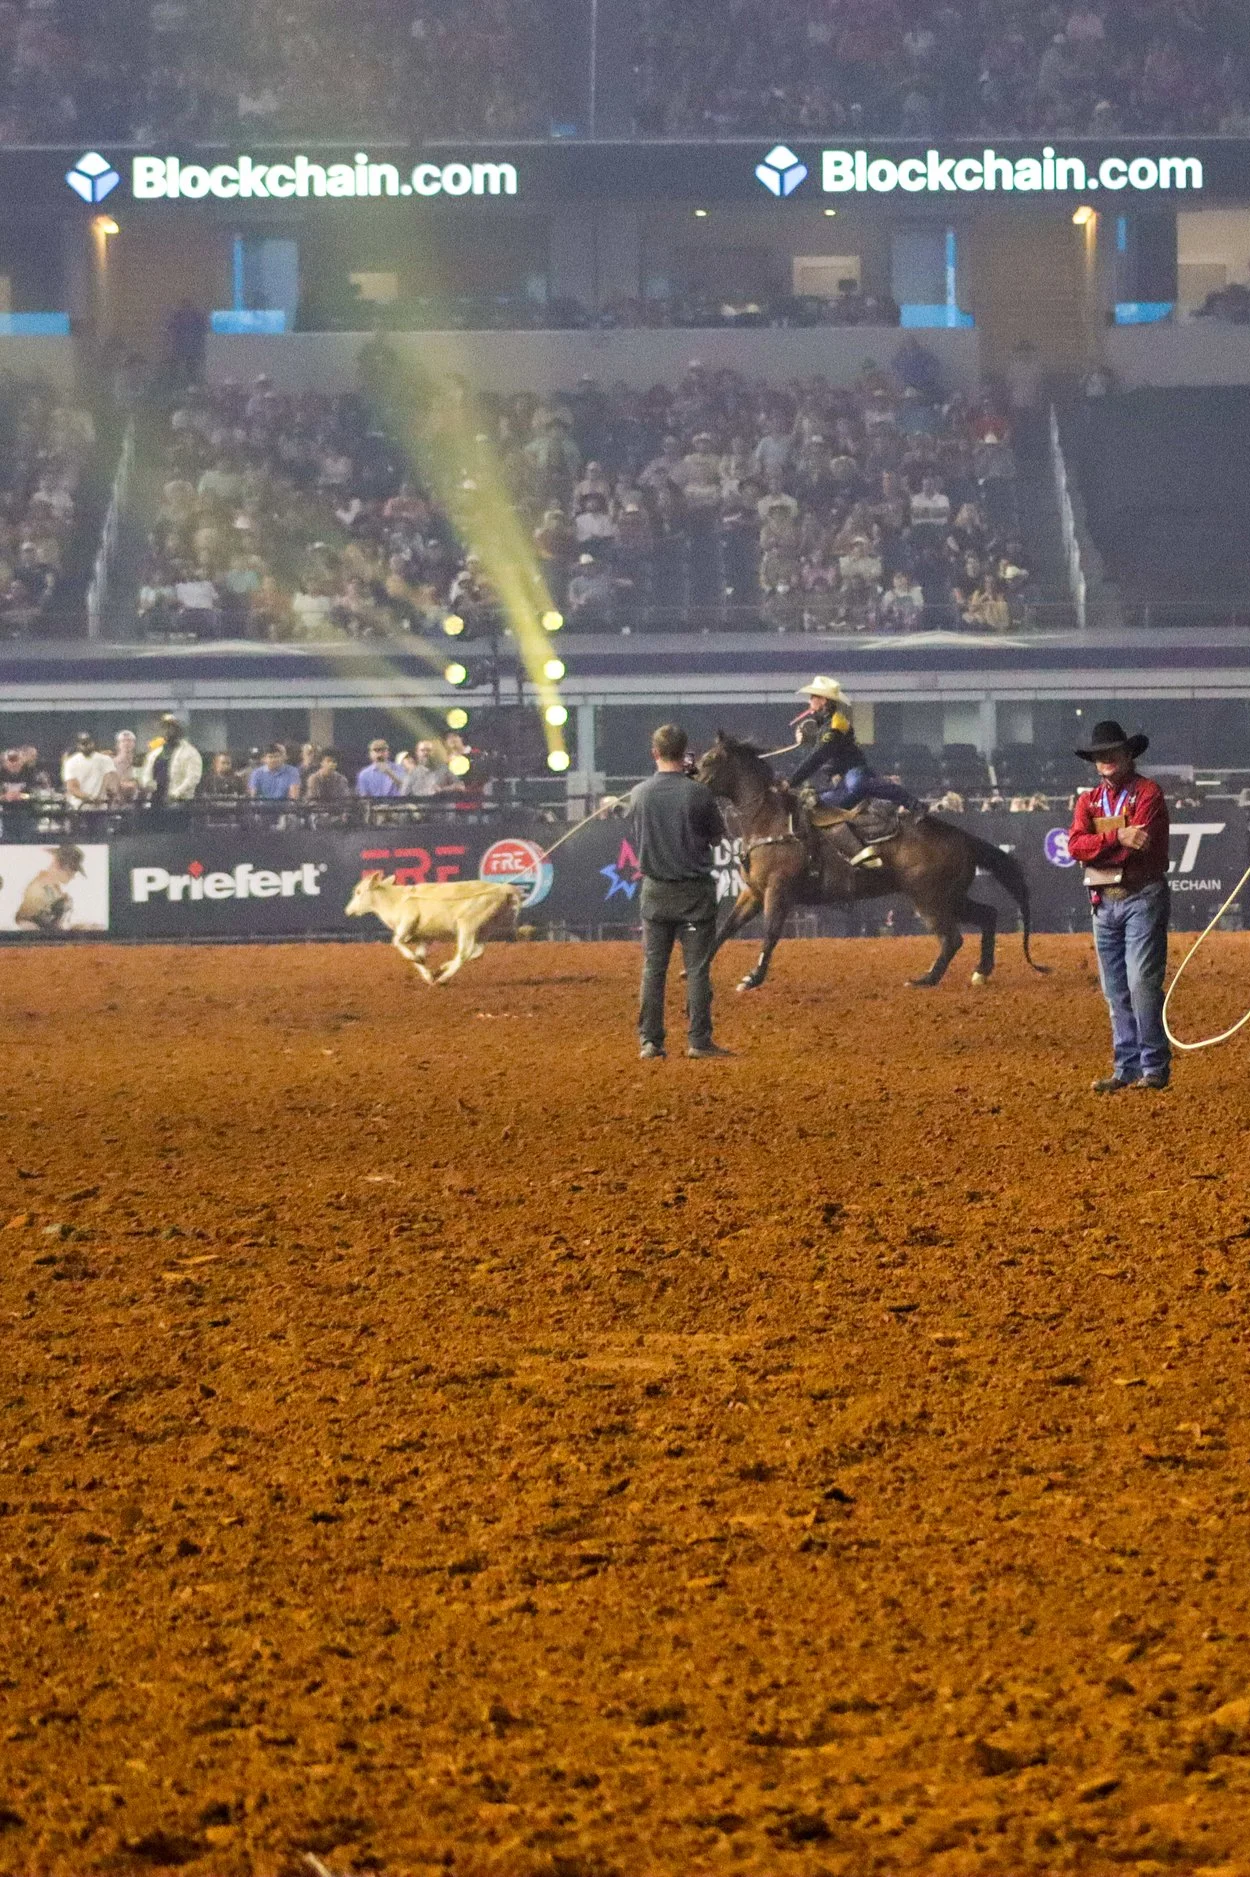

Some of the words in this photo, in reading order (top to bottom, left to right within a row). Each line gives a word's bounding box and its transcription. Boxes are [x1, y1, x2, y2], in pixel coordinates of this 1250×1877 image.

[132, 152, 518, 198] Blockchain.com
[822, 146, 1203, 192] Blockchain.com
[131, 861, 321, 902] Priefert
